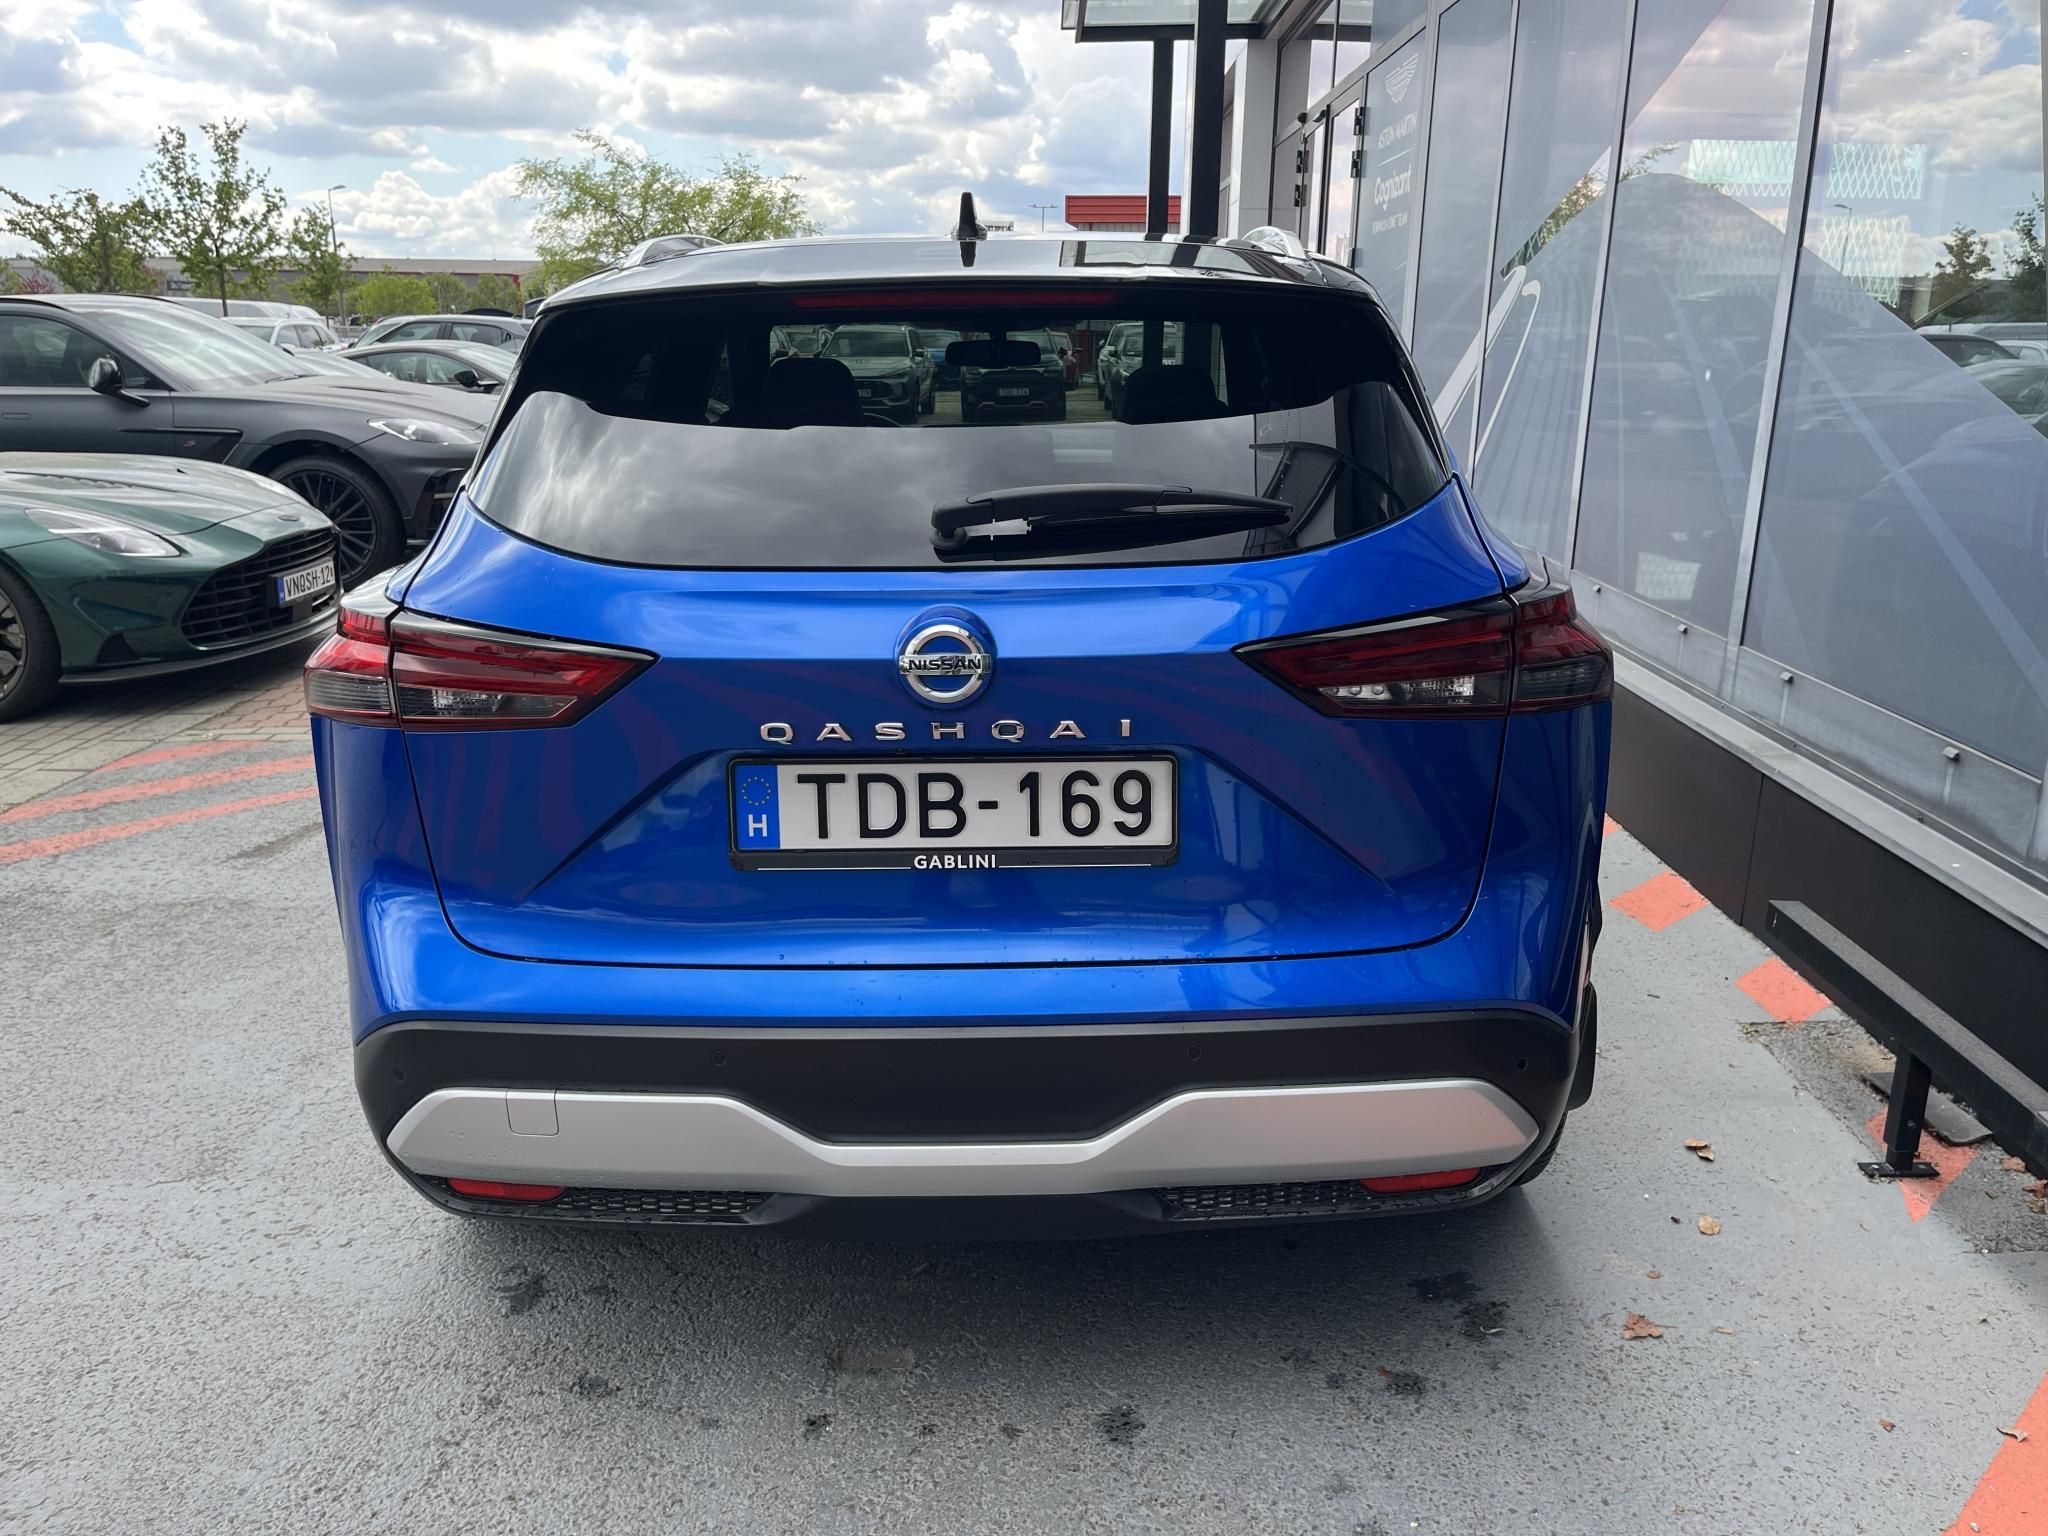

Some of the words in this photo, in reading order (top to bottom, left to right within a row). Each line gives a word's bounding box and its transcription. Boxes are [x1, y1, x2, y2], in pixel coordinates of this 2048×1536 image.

[1374, 163, 1412, 211] Cognizant
[908, 658, 982, 671] NISSAN
[760, 719, 1131, 744] QASHQAI
[797, 769, 1152, 839] TDB-169
[748, 814, 768, 838] H
[914, 855, 997, 869] GABLINI
